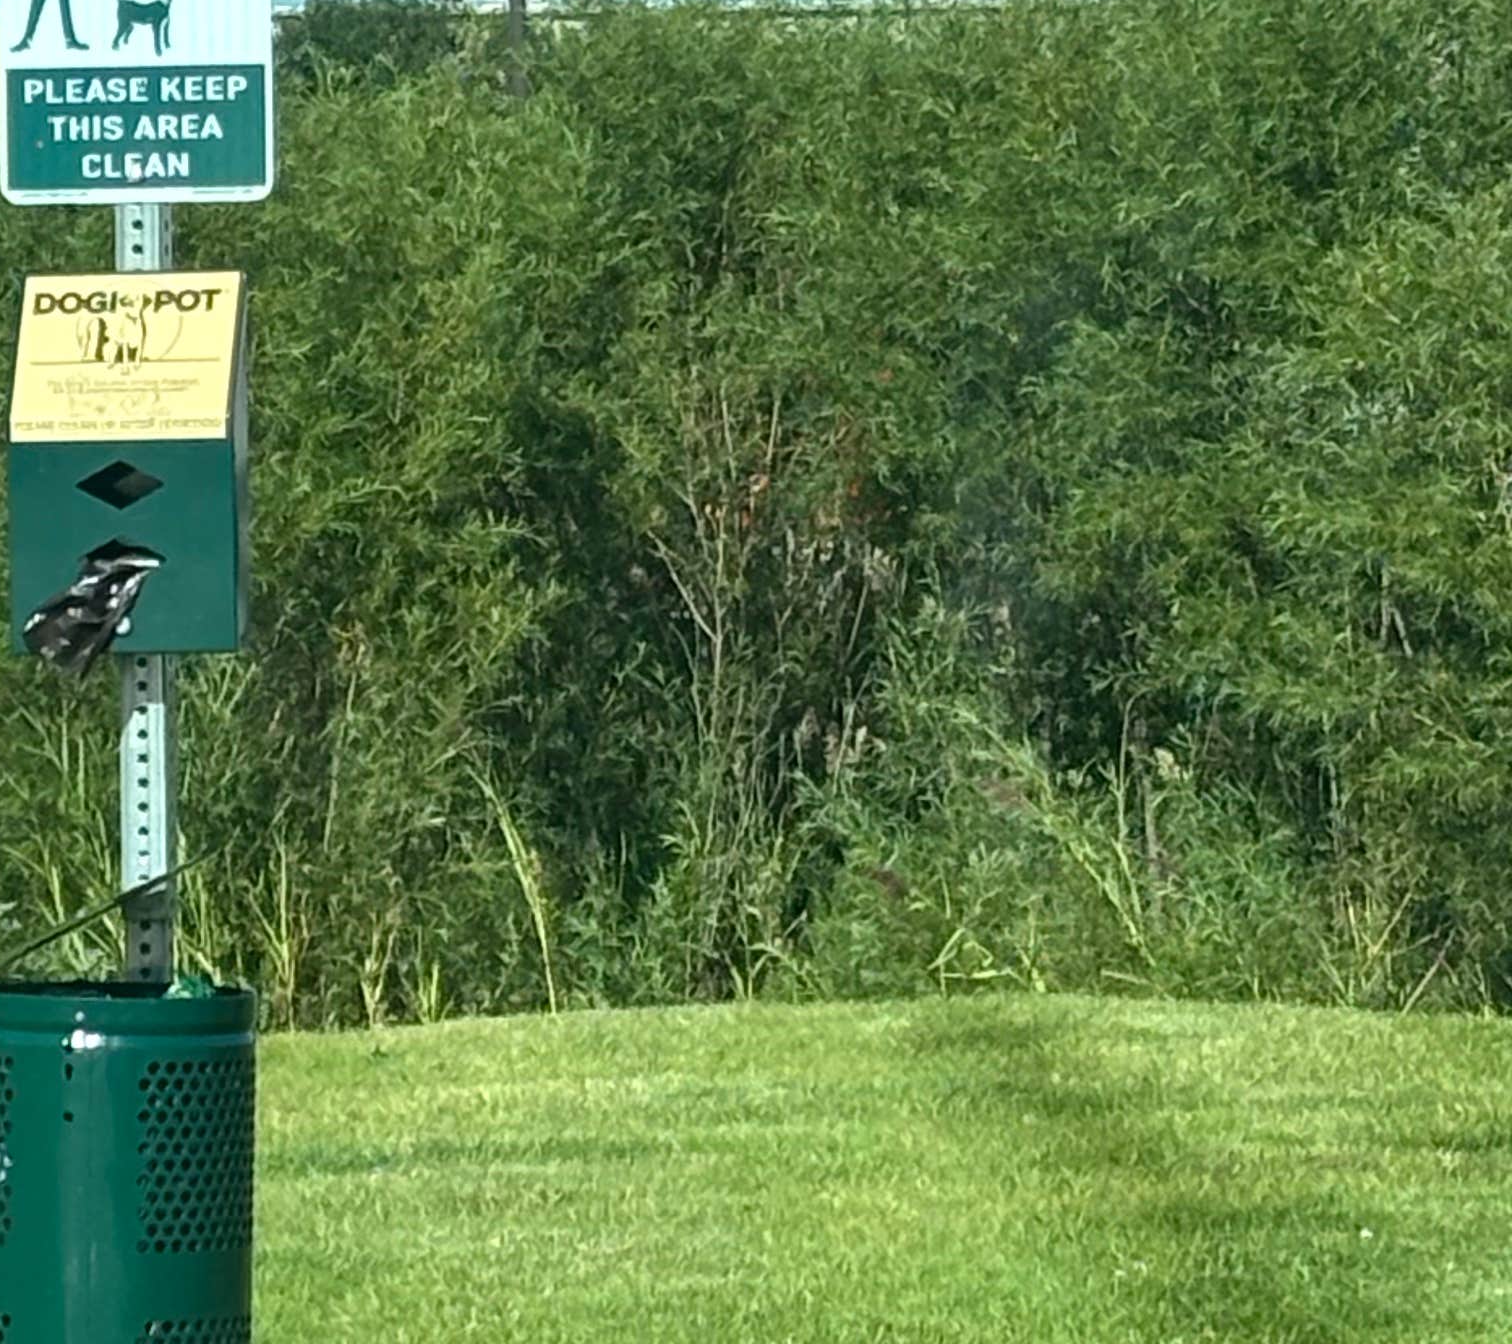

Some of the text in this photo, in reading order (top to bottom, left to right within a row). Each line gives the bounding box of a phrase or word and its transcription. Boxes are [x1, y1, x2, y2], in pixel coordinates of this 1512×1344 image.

[23, 75, 248, 104] PLEASE KEEP
[48, 113, 224, 142] THIS AREA
[81, 152, 190, 179] CLEAN
